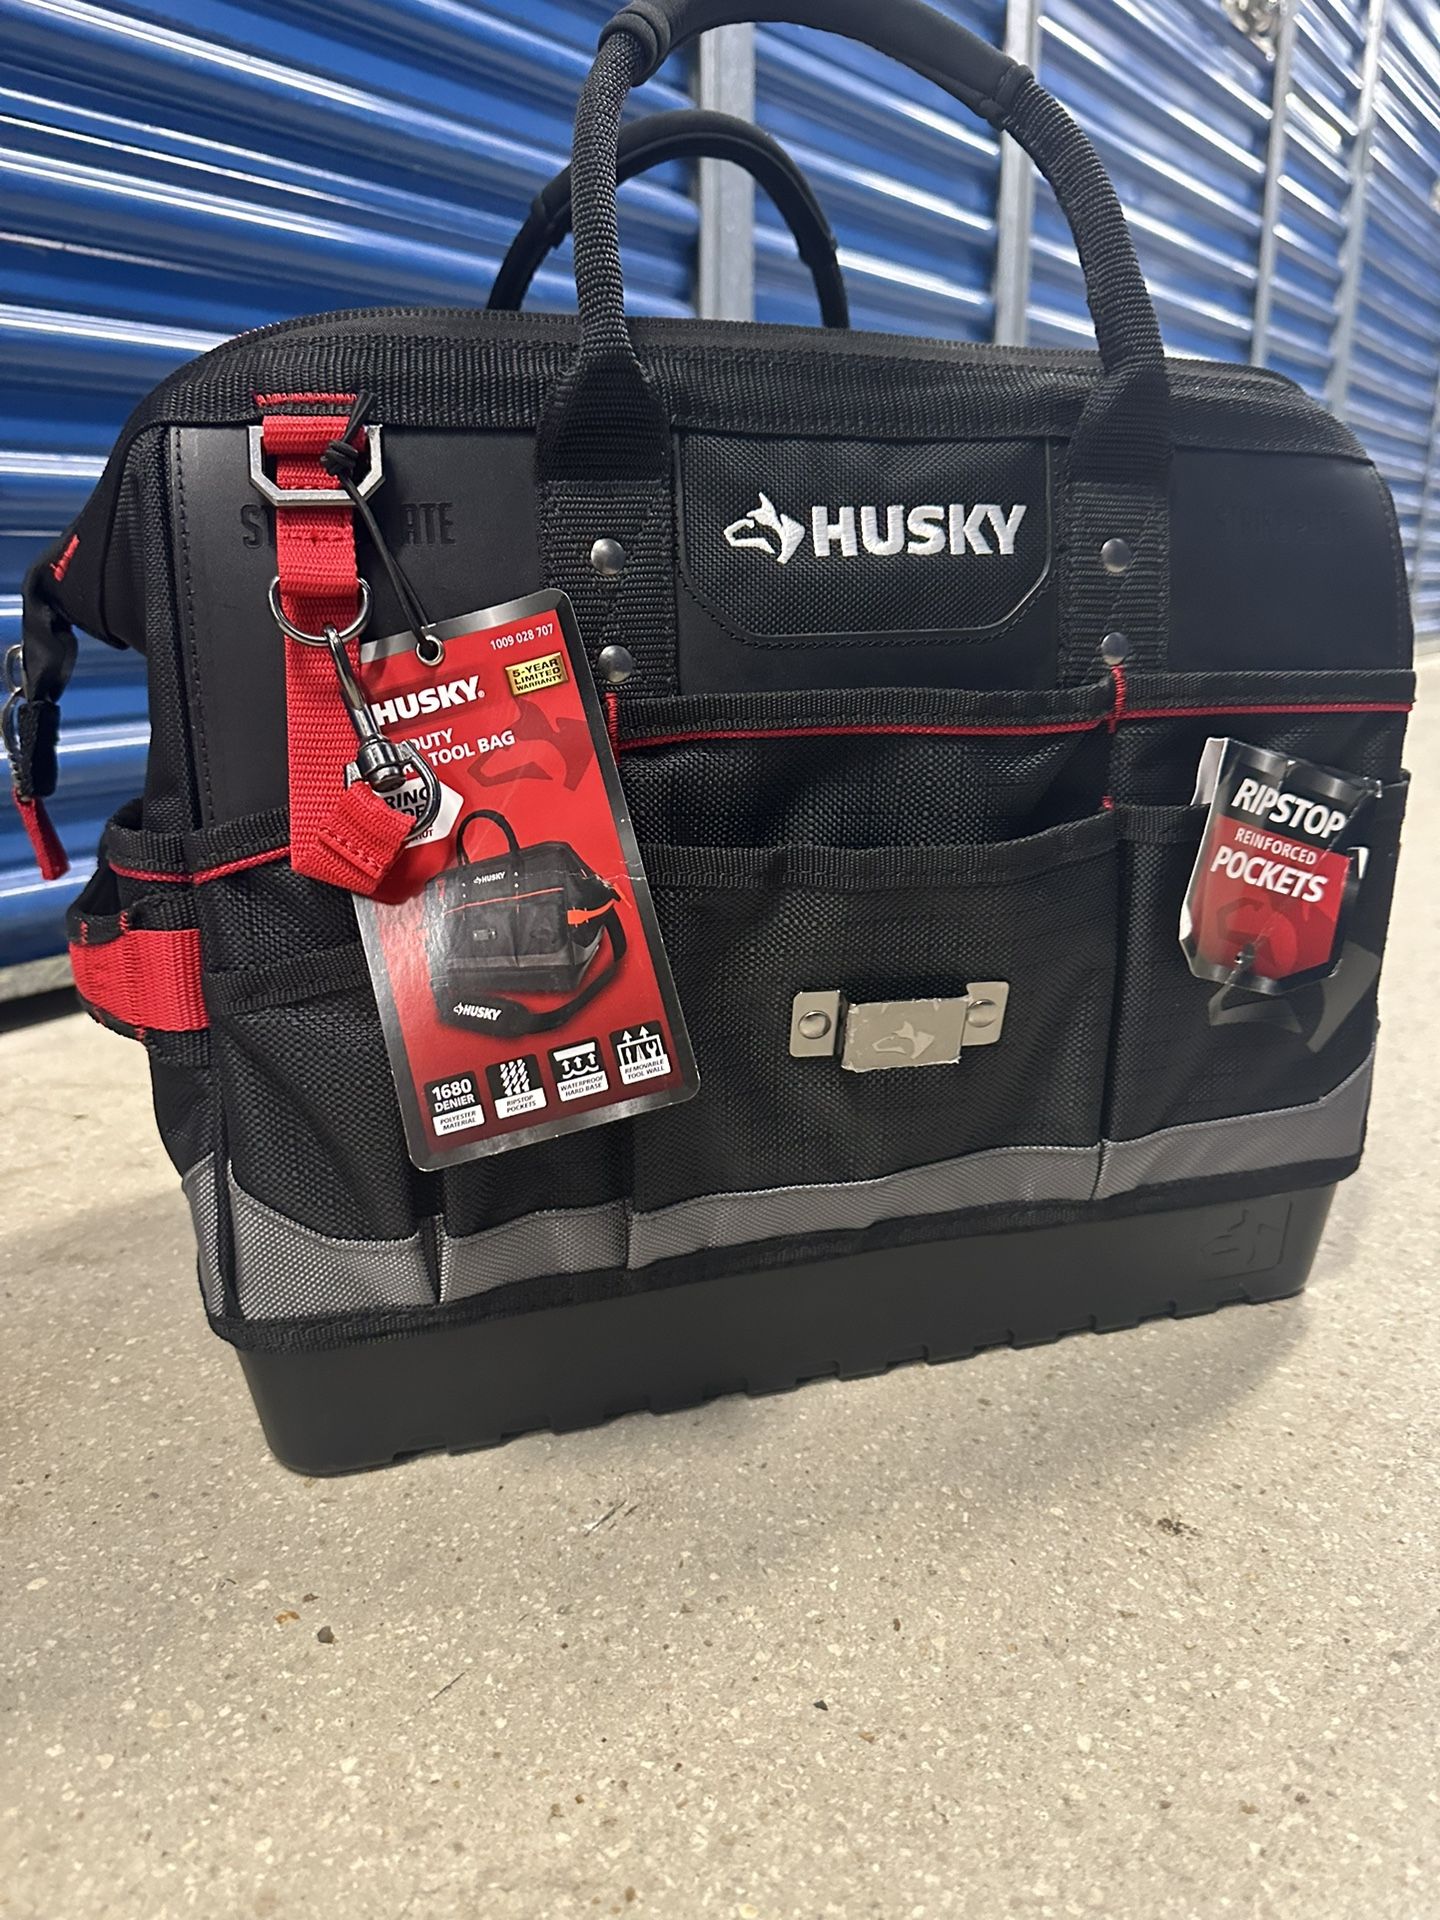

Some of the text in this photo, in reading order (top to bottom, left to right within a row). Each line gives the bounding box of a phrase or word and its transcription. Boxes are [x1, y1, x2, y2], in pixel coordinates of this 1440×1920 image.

[811, 503, 1027, 557] HUSKY
[490, 623, 553, 651] 1009 028 707
[512, 658, 559, 678] 5-YEAR
[514, 666, 561, 685] LIMITED
[516, 674, 562, 692] WARRANTY
[427, 730, 516, 768] TOOL BAG
[1231, 778, 1348, 840] RIPSTOP
[1234, 827, 1318, 866] REINFORCED
[481, 871, 506, 884] HUSKY
[1210, 845, 1329, 904] POCKETS
[463, 1003, 502, 1022] HUSKY
[624, 1058, 665, 1074] REMOVABLE
[627, 1065, 665, 1080] TOOL WALL
[431, 1078, 473, 1101] 1680
[560, 1075, 604, 1092] WATERPROOF
[565, 1082, 602, 1097] HARD BASE
[434, 1093, 476, 1113] DENIER
[506, 1094, 534, 1107] RIPSTOP
[506, 1101, 537, 1114] POCKETS
[440, 1110, 477, 1125] POLYESTER
[442, 1118, 477, 1131] MATERIAL
